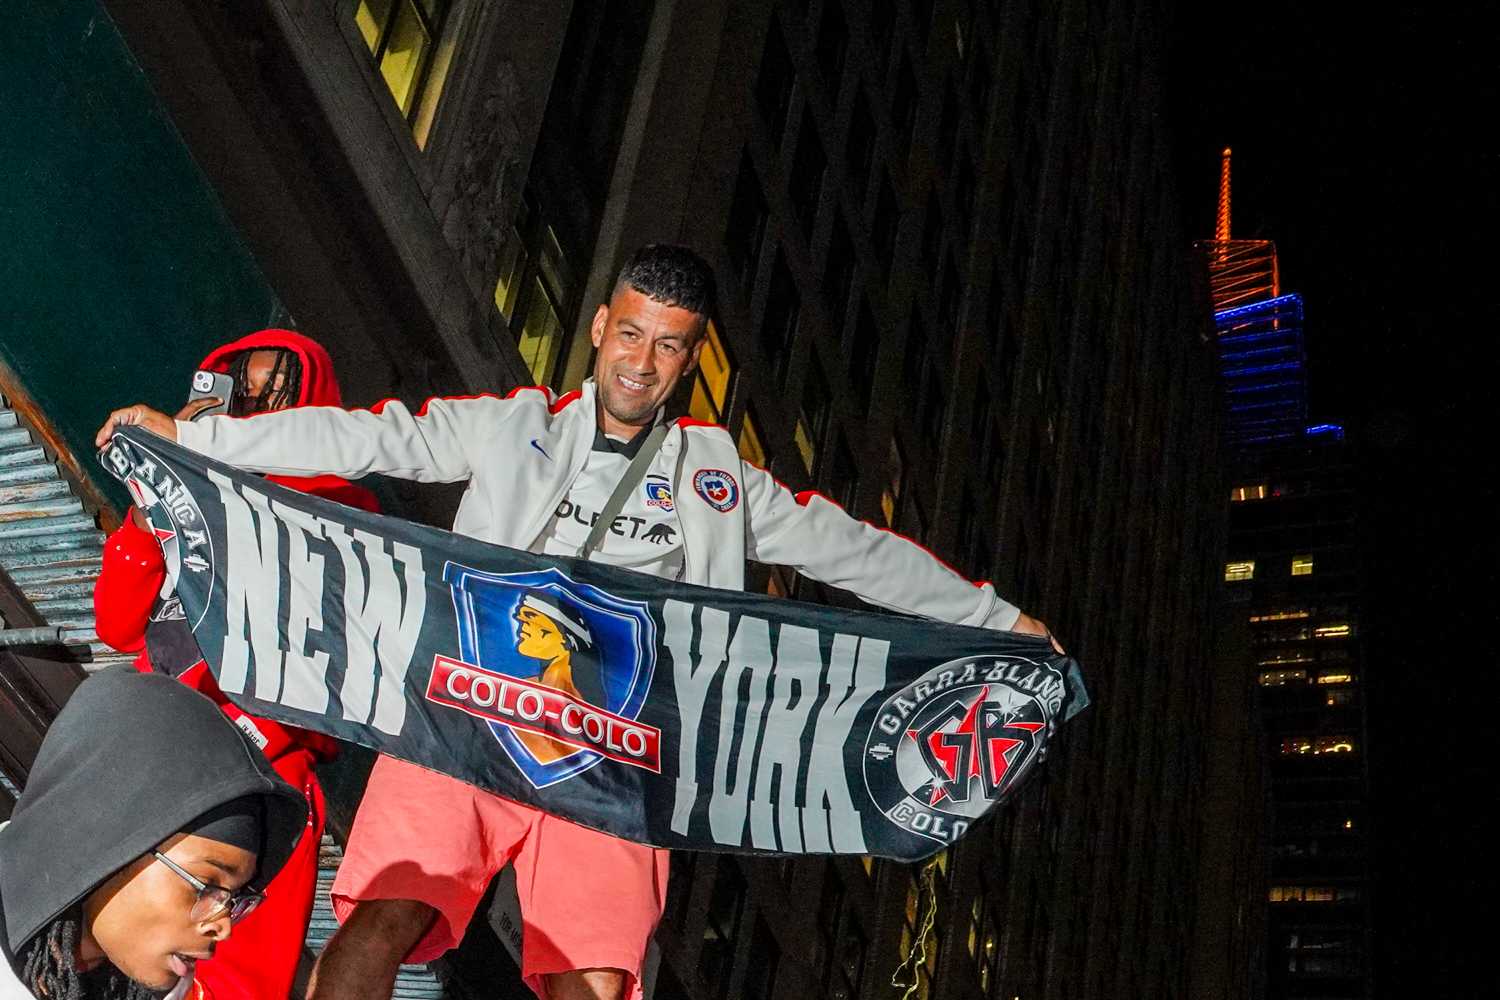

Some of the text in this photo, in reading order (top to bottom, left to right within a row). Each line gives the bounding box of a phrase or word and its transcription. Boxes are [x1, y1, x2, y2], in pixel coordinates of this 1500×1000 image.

[207, 468, 890, 853] NEW YORK
[878, 660, 1064, 736] GARRA-BLANC
[445, 667, 648, 758] COLO-COLO
